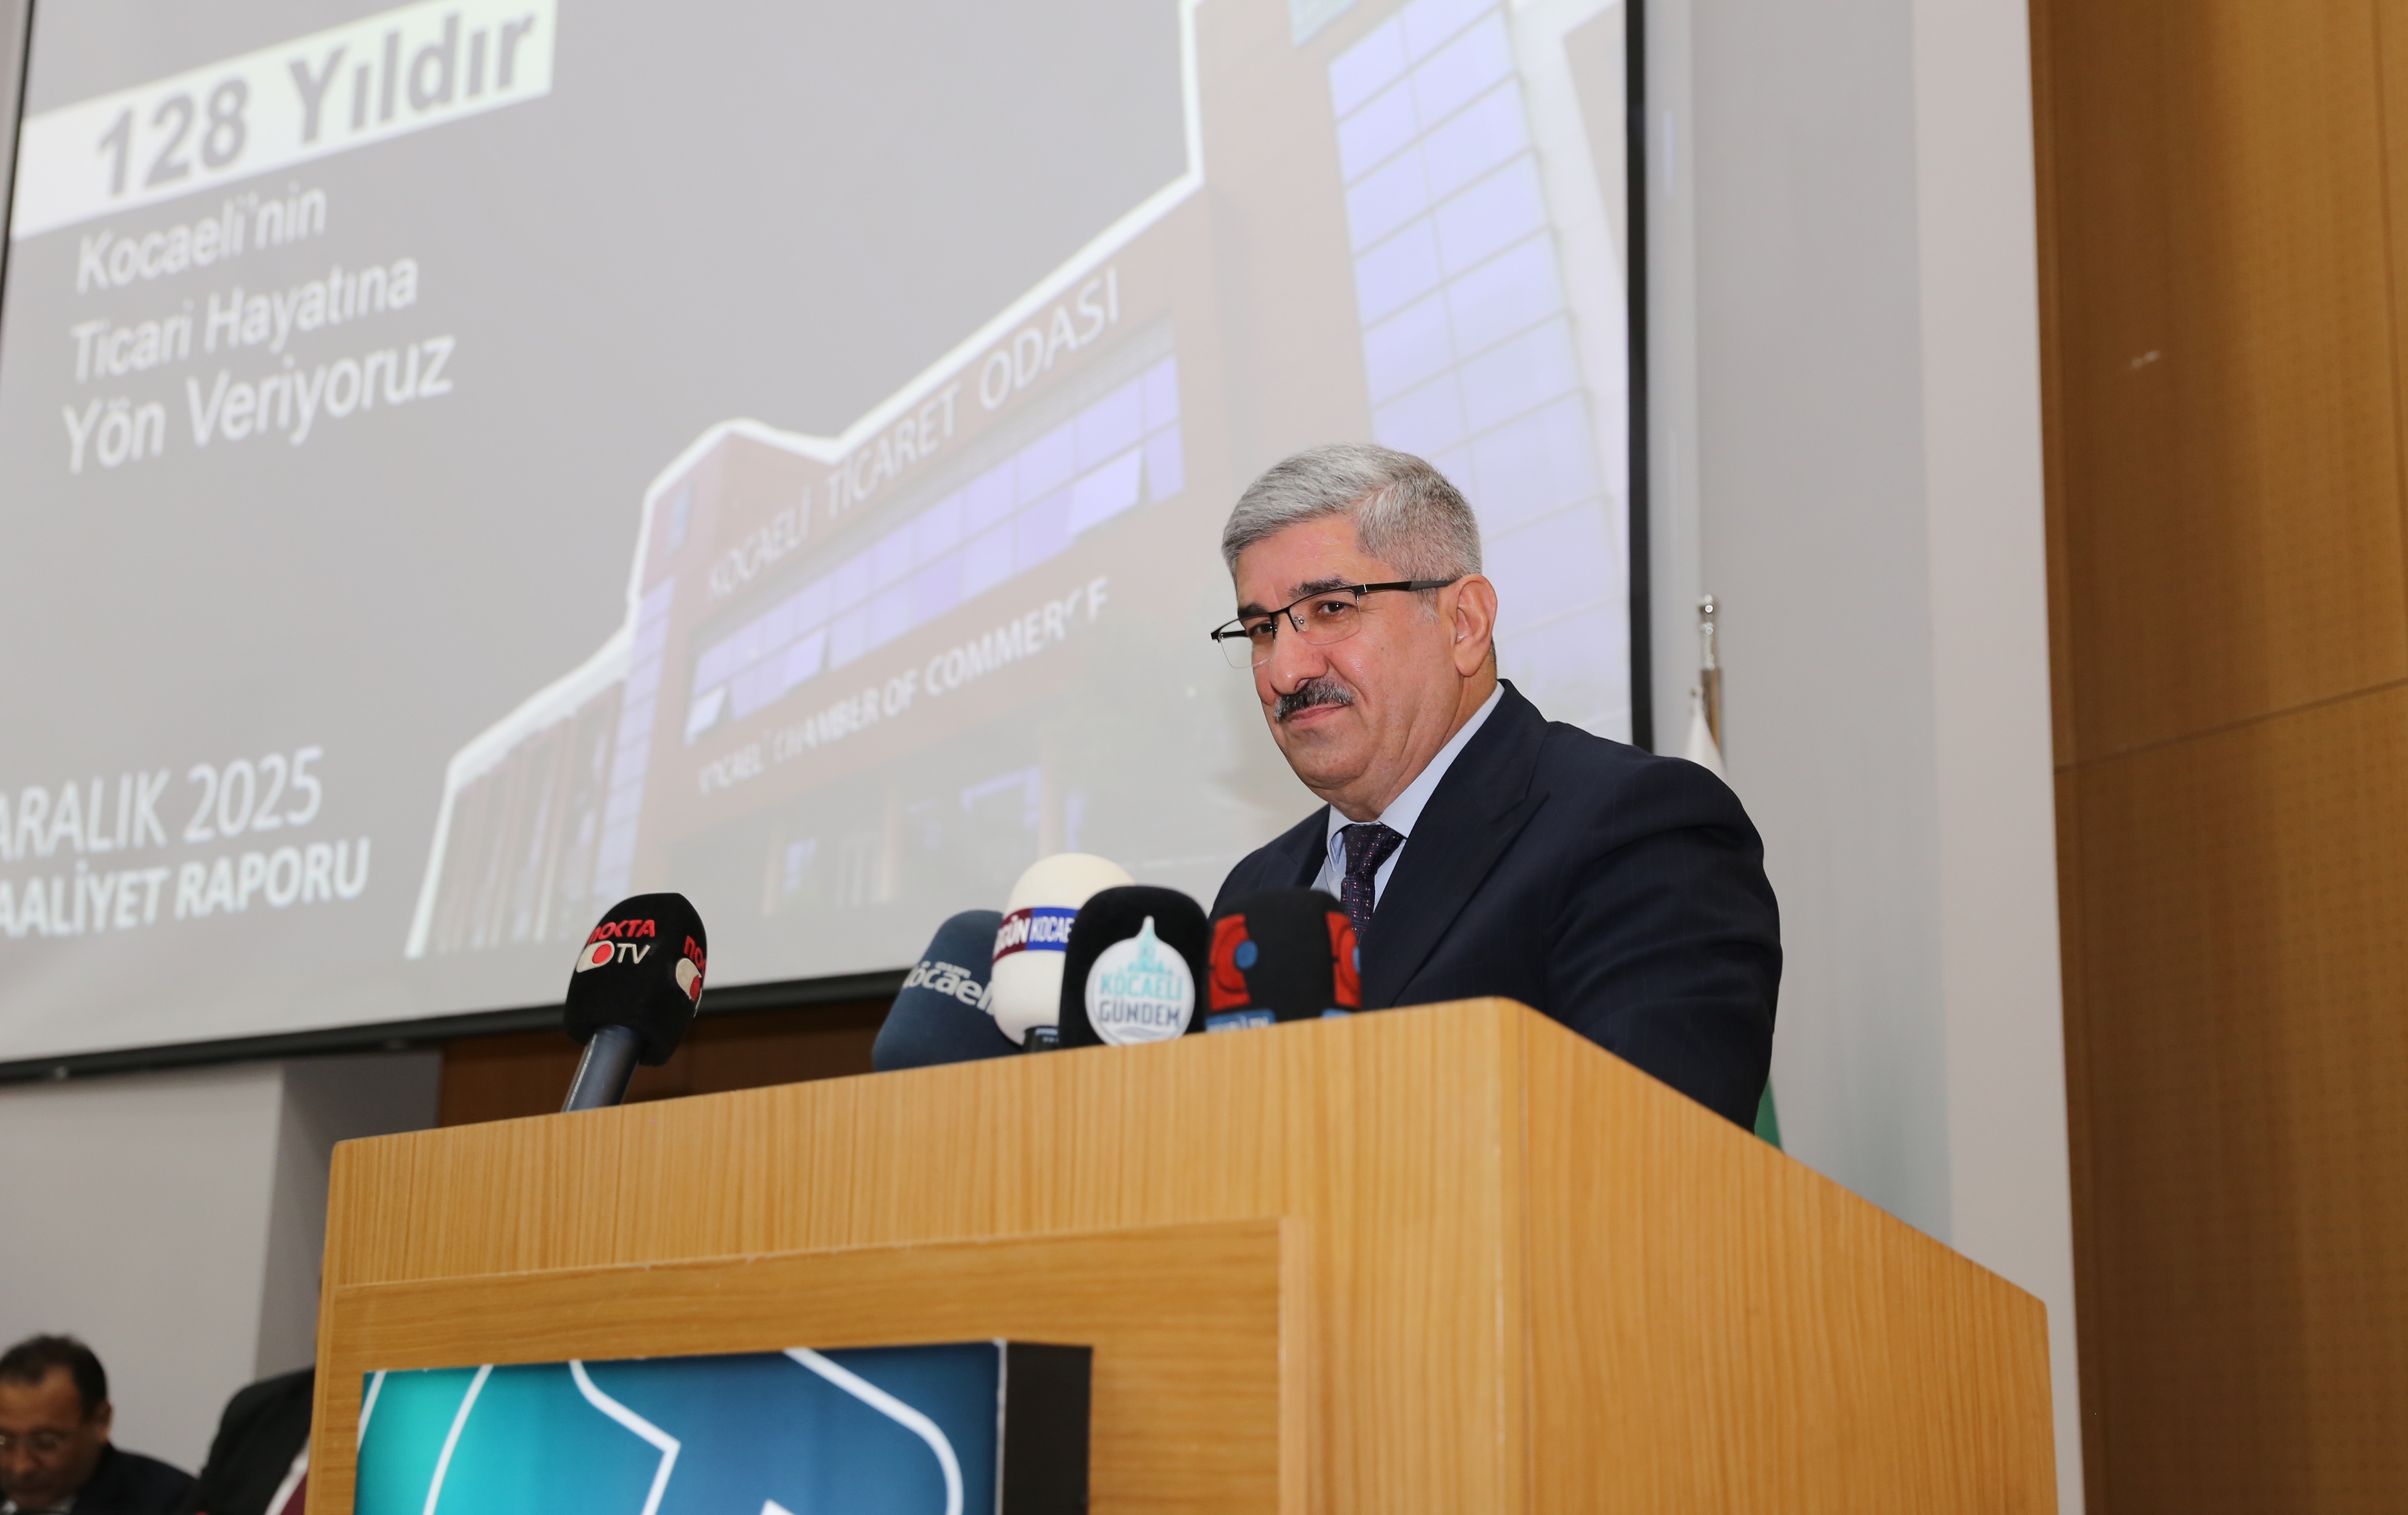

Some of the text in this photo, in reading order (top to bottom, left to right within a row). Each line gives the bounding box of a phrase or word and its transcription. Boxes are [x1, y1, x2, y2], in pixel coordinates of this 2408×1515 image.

[96, 10, 537, 196] 128 Yıldır
[77, 183, 326, 294] Kocaeli'nin
[71, 257, 418, 383] Ticari Hayatına
[979, 267, 1119, 410] ODASI
[63, 335, 455, 474] Yön Veriyoruz
[883, 668, 919, 718] OF
[183, 745, 323, 843] 2025
[175, 836, 370, 920] RAPORU
[617, 943, 651, 964] TV
